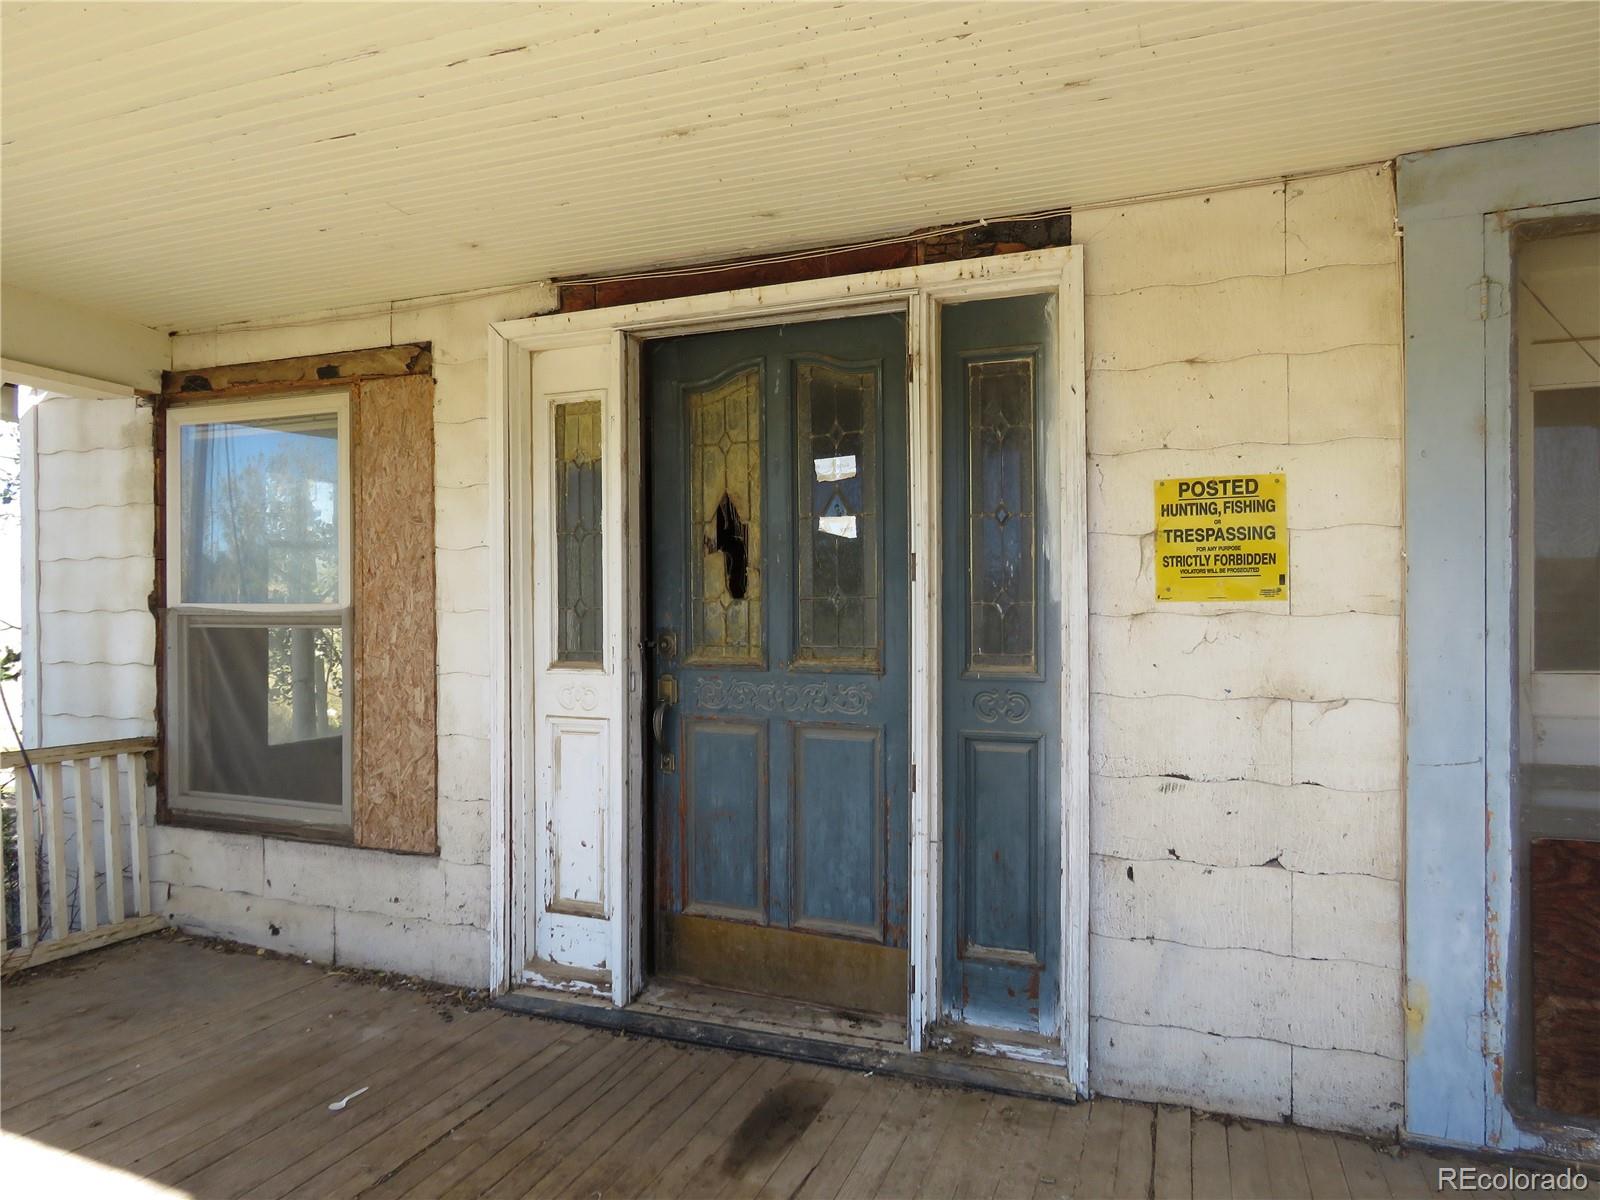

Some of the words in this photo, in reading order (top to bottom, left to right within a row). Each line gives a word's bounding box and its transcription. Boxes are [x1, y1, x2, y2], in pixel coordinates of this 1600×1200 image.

[1178, 478, 1259, 497] POSTED
[1161, 501, 1222, 517] HUNTING,
[1223, 499, 1276, 514] FISHING
[1163, 525, 1276, 543] TRESPASSING
[1162, 554, 1211, 567] STRICTLY
[1213, 553, 1276, 566] FORBIDDEN
